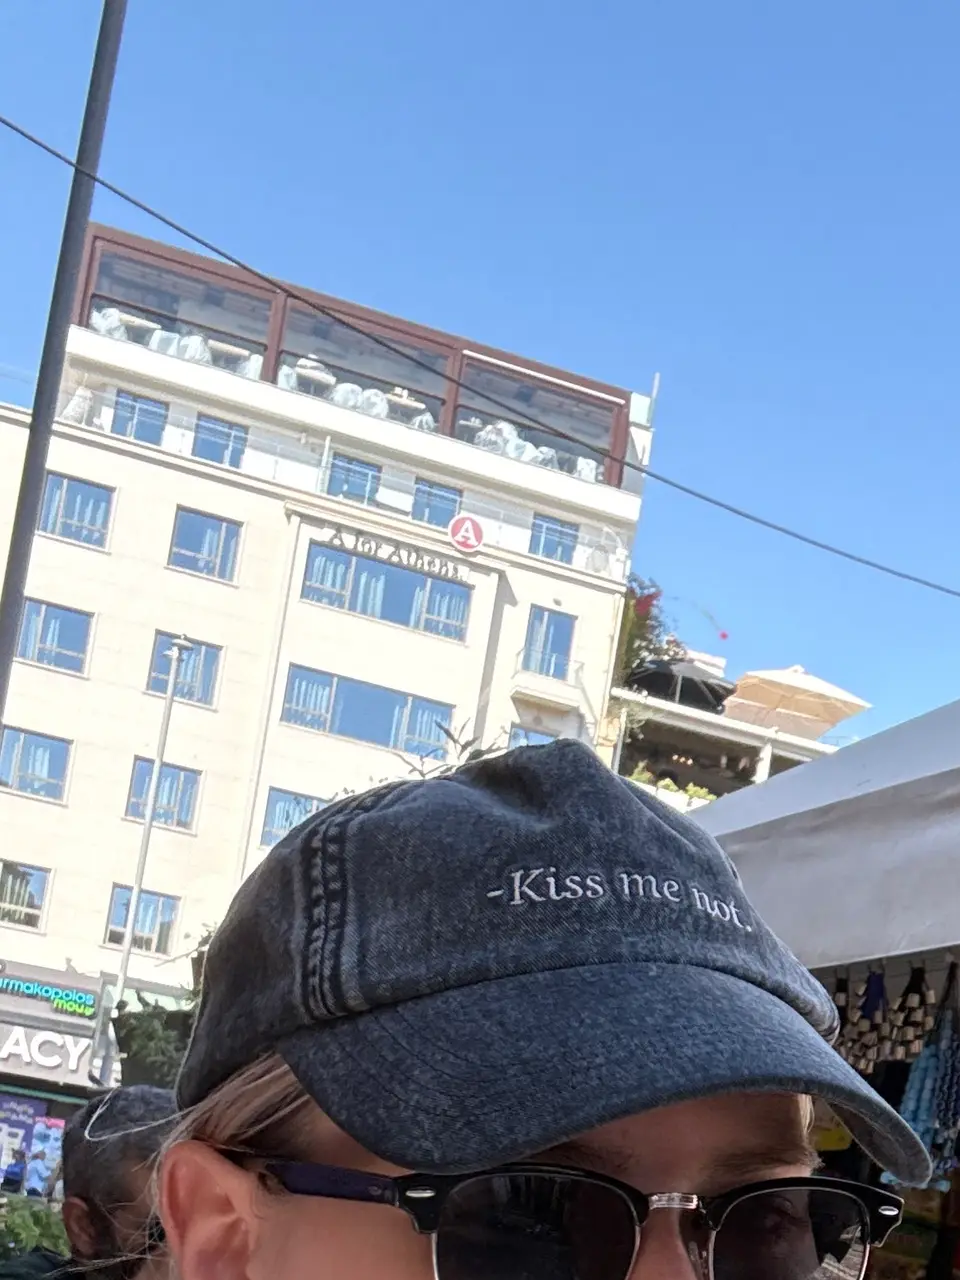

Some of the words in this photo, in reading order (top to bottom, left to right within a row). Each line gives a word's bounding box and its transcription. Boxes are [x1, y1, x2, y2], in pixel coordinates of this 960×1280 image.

[329, 526, 350, 551] A
[453, 519, 479, 547] A
[619, 871, 682, 903] me
[691, 886, 753, 933] not.
[0, 1026, 91, 1070] ACY
